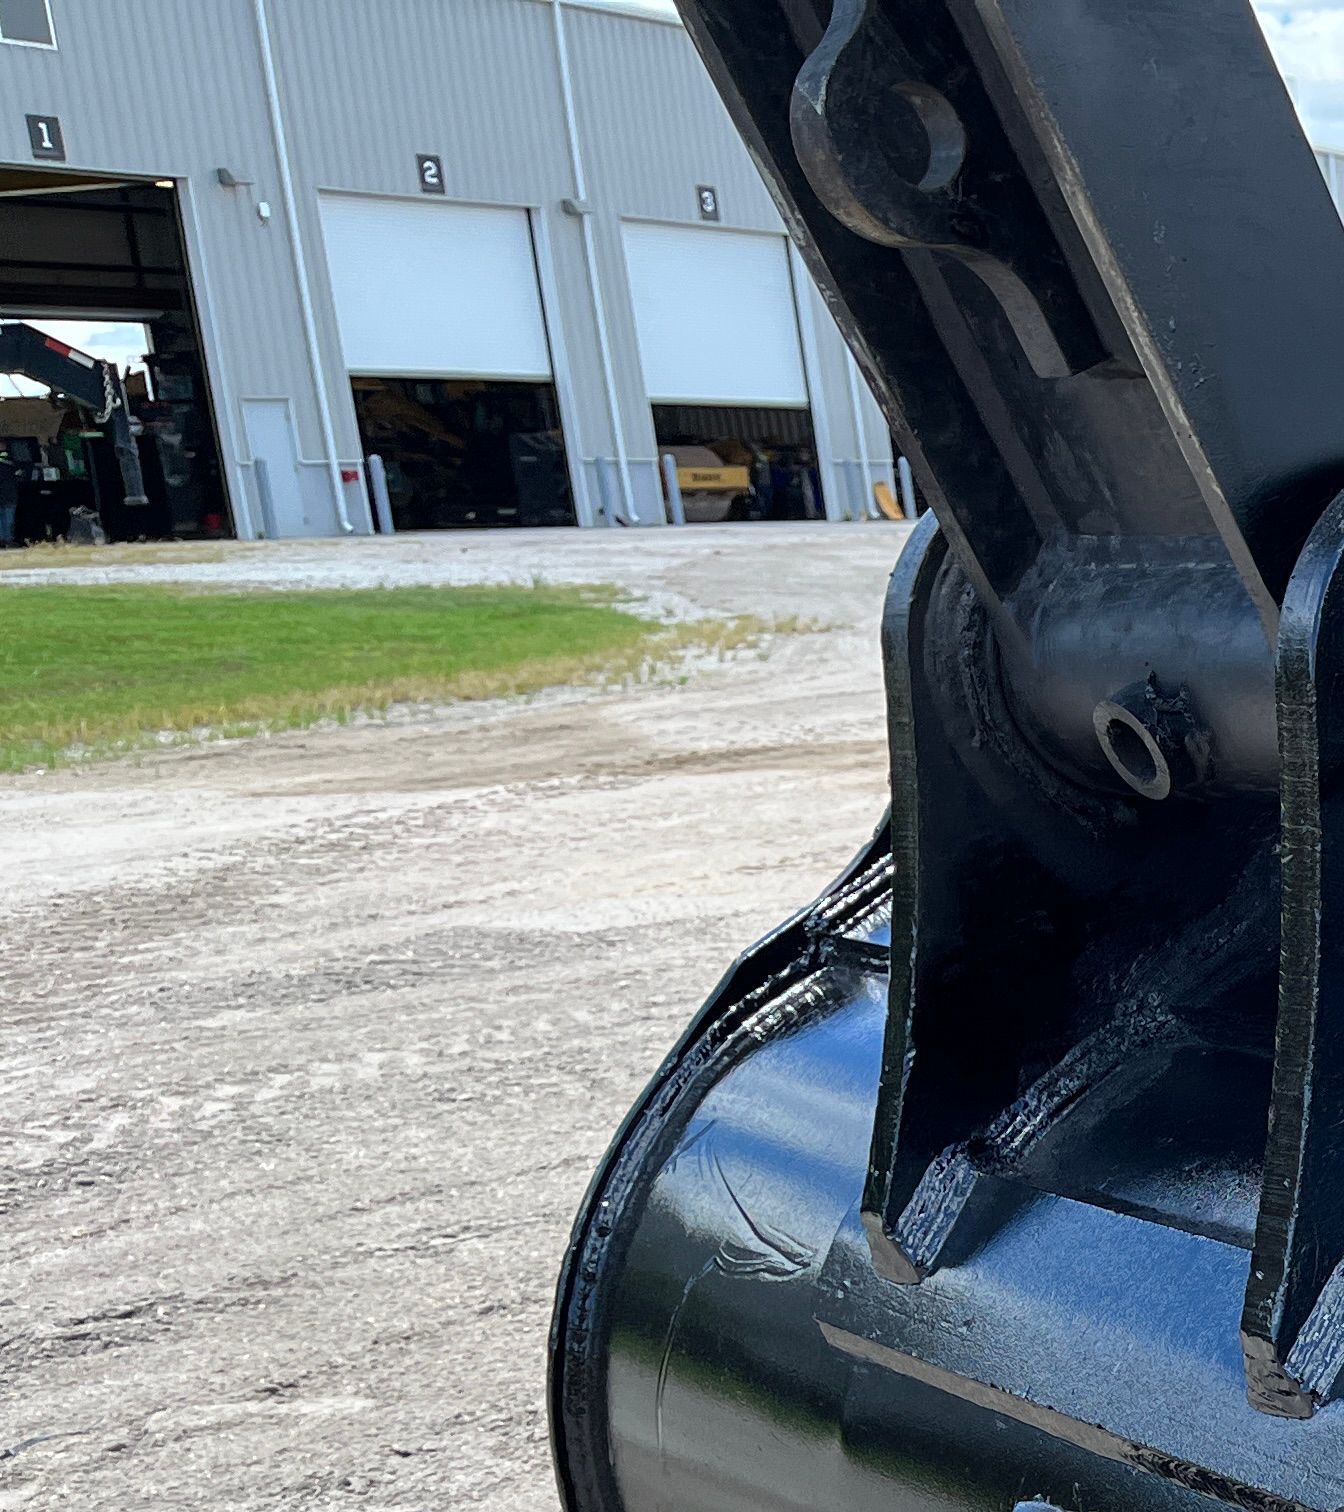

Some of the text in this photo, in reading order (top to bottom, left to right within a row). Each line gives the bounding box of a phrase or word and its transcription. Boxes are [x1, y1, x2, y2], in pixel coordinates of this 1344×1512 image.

[38, 122, 53, 148] 1
[423, 161, 439, 184] 2
[702, 191, 714, 212] 3
